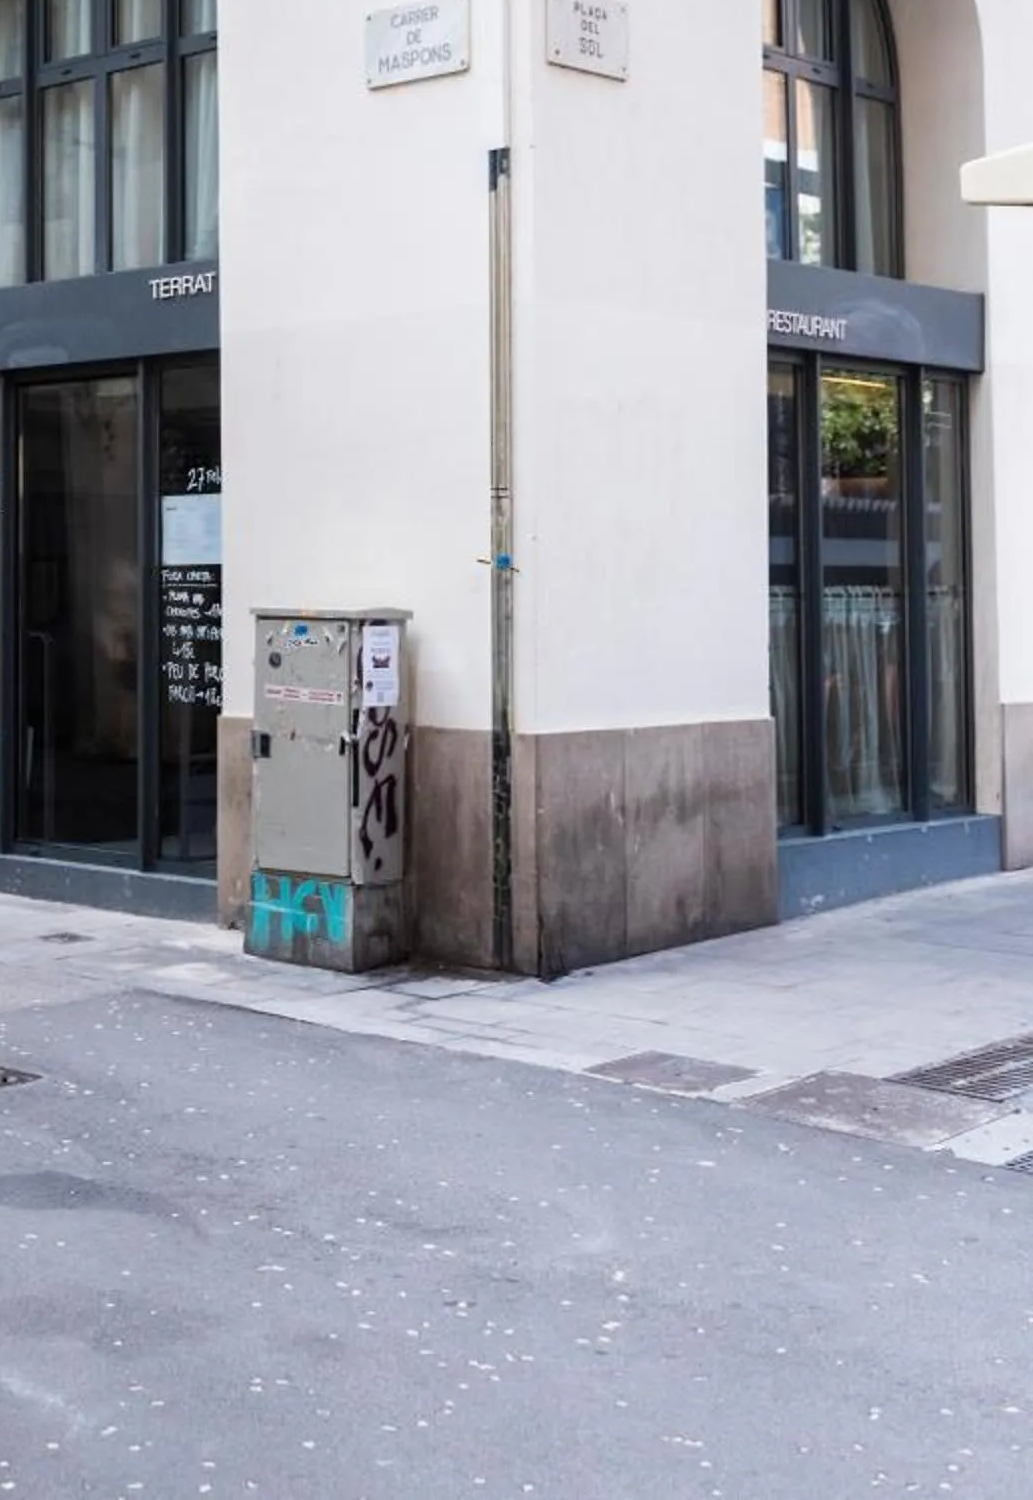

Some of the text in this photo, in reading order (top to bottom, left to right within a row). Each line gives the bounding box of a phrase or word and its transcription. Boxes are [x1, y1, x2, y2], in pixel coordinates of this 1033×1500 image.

[390, 5, 439, 29] CARRER
[581, 19, 600, 35] DEL
[406, 28, 422, 46] DE
[578, 36, 605, 58] SOL
[378, 42, 452, 74] MASPONS
[149, 271, 216, 299] TERRAT
[767, 309, 848, 341] RESTAURANT
